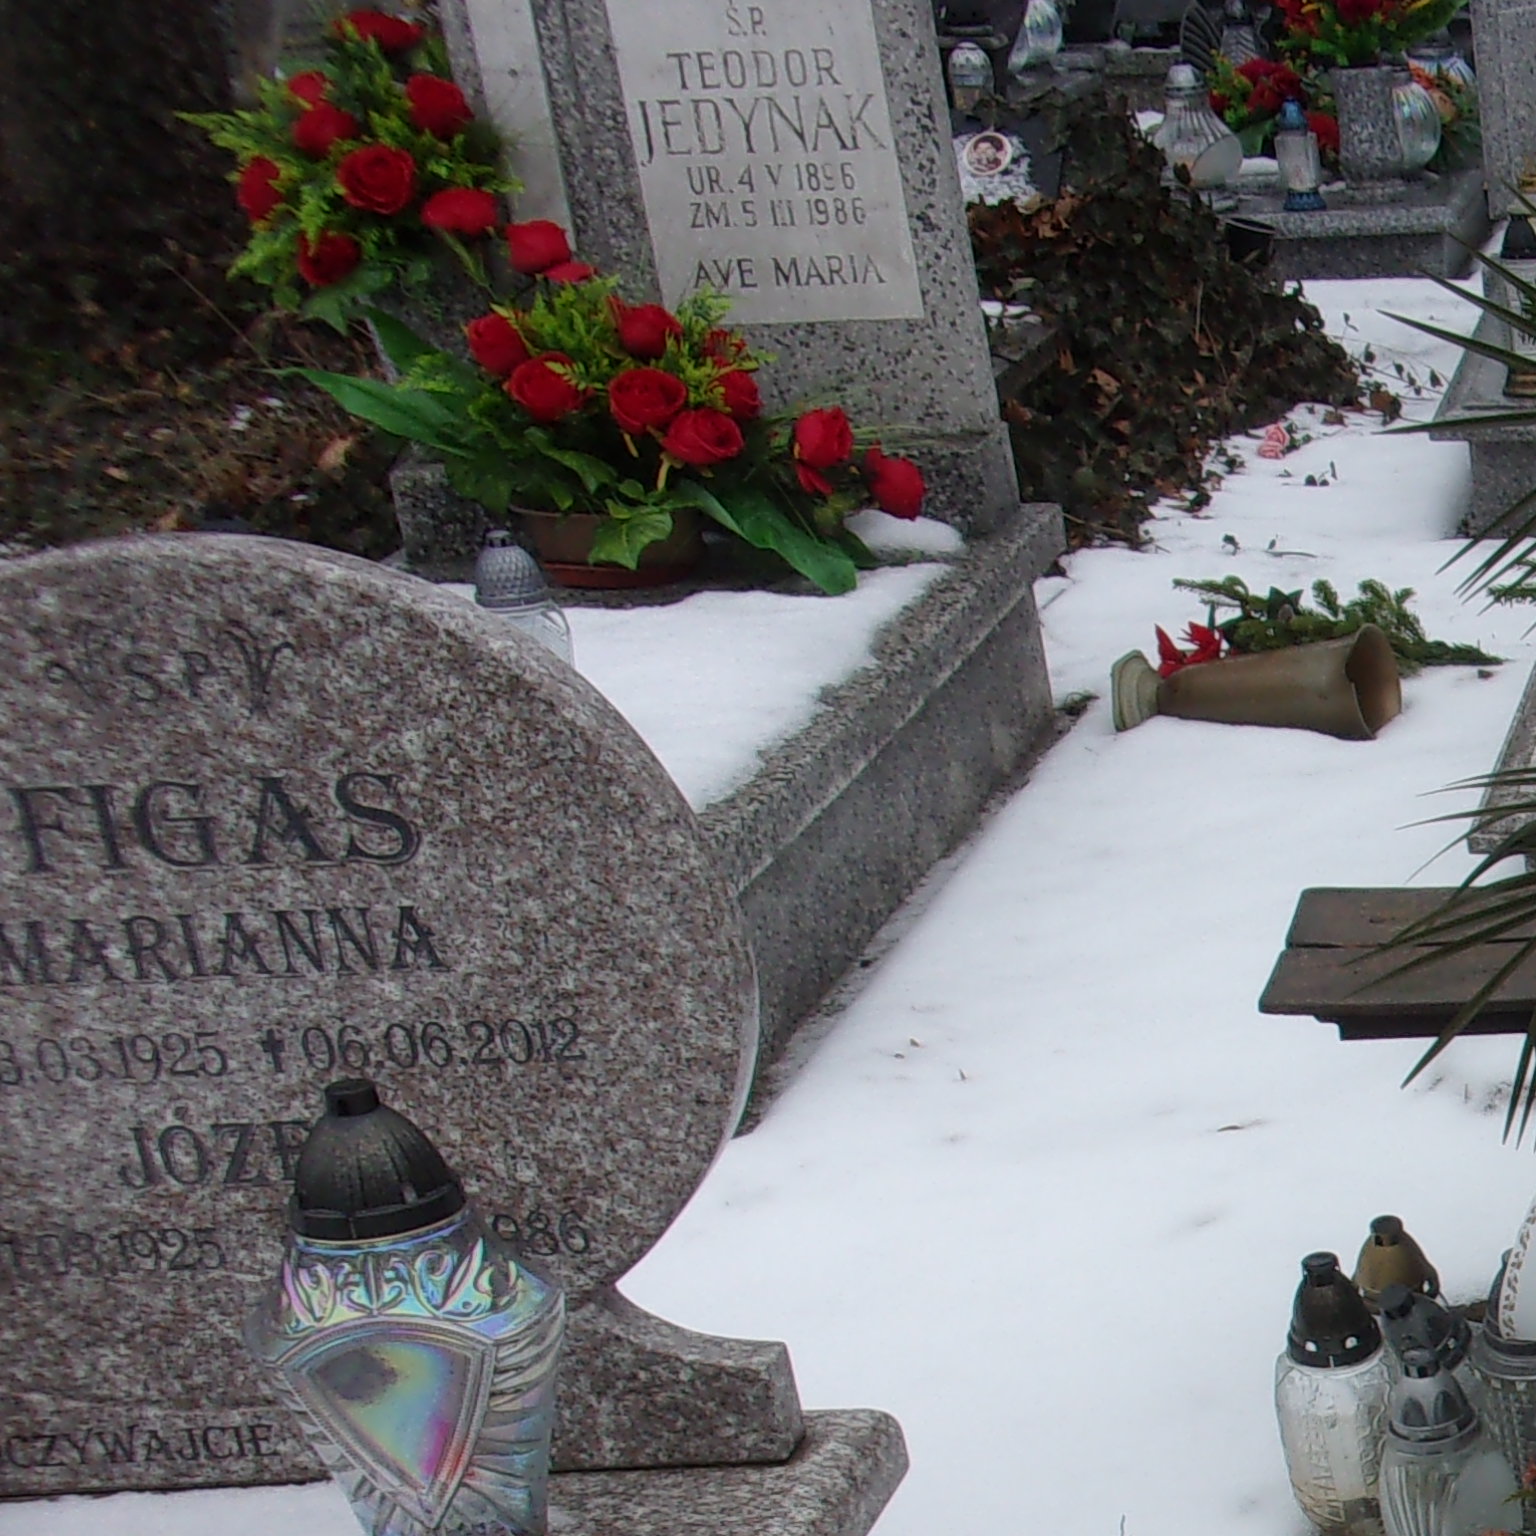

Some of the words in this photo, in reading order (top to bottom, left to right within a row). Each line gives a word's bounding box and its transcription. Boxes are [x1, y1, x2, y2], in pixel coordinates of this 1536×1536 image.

[666, 48, 842, 91] TEODOR
[638, 93, 888, 167] JEDYNAK
[765, 163, 783, 186] V
[808, 197, 867, 226] 1986
[693, 258, 758, 289] AVE
[771, 254, 887, 288] MARIA
[7, 772, 423, 874] FIGAS
[0, 904, 447, 986] MARIANNA
[494, 1208, 591, 1256] 986
[0, 1422, 281, 1469] CZYWAJCIE
